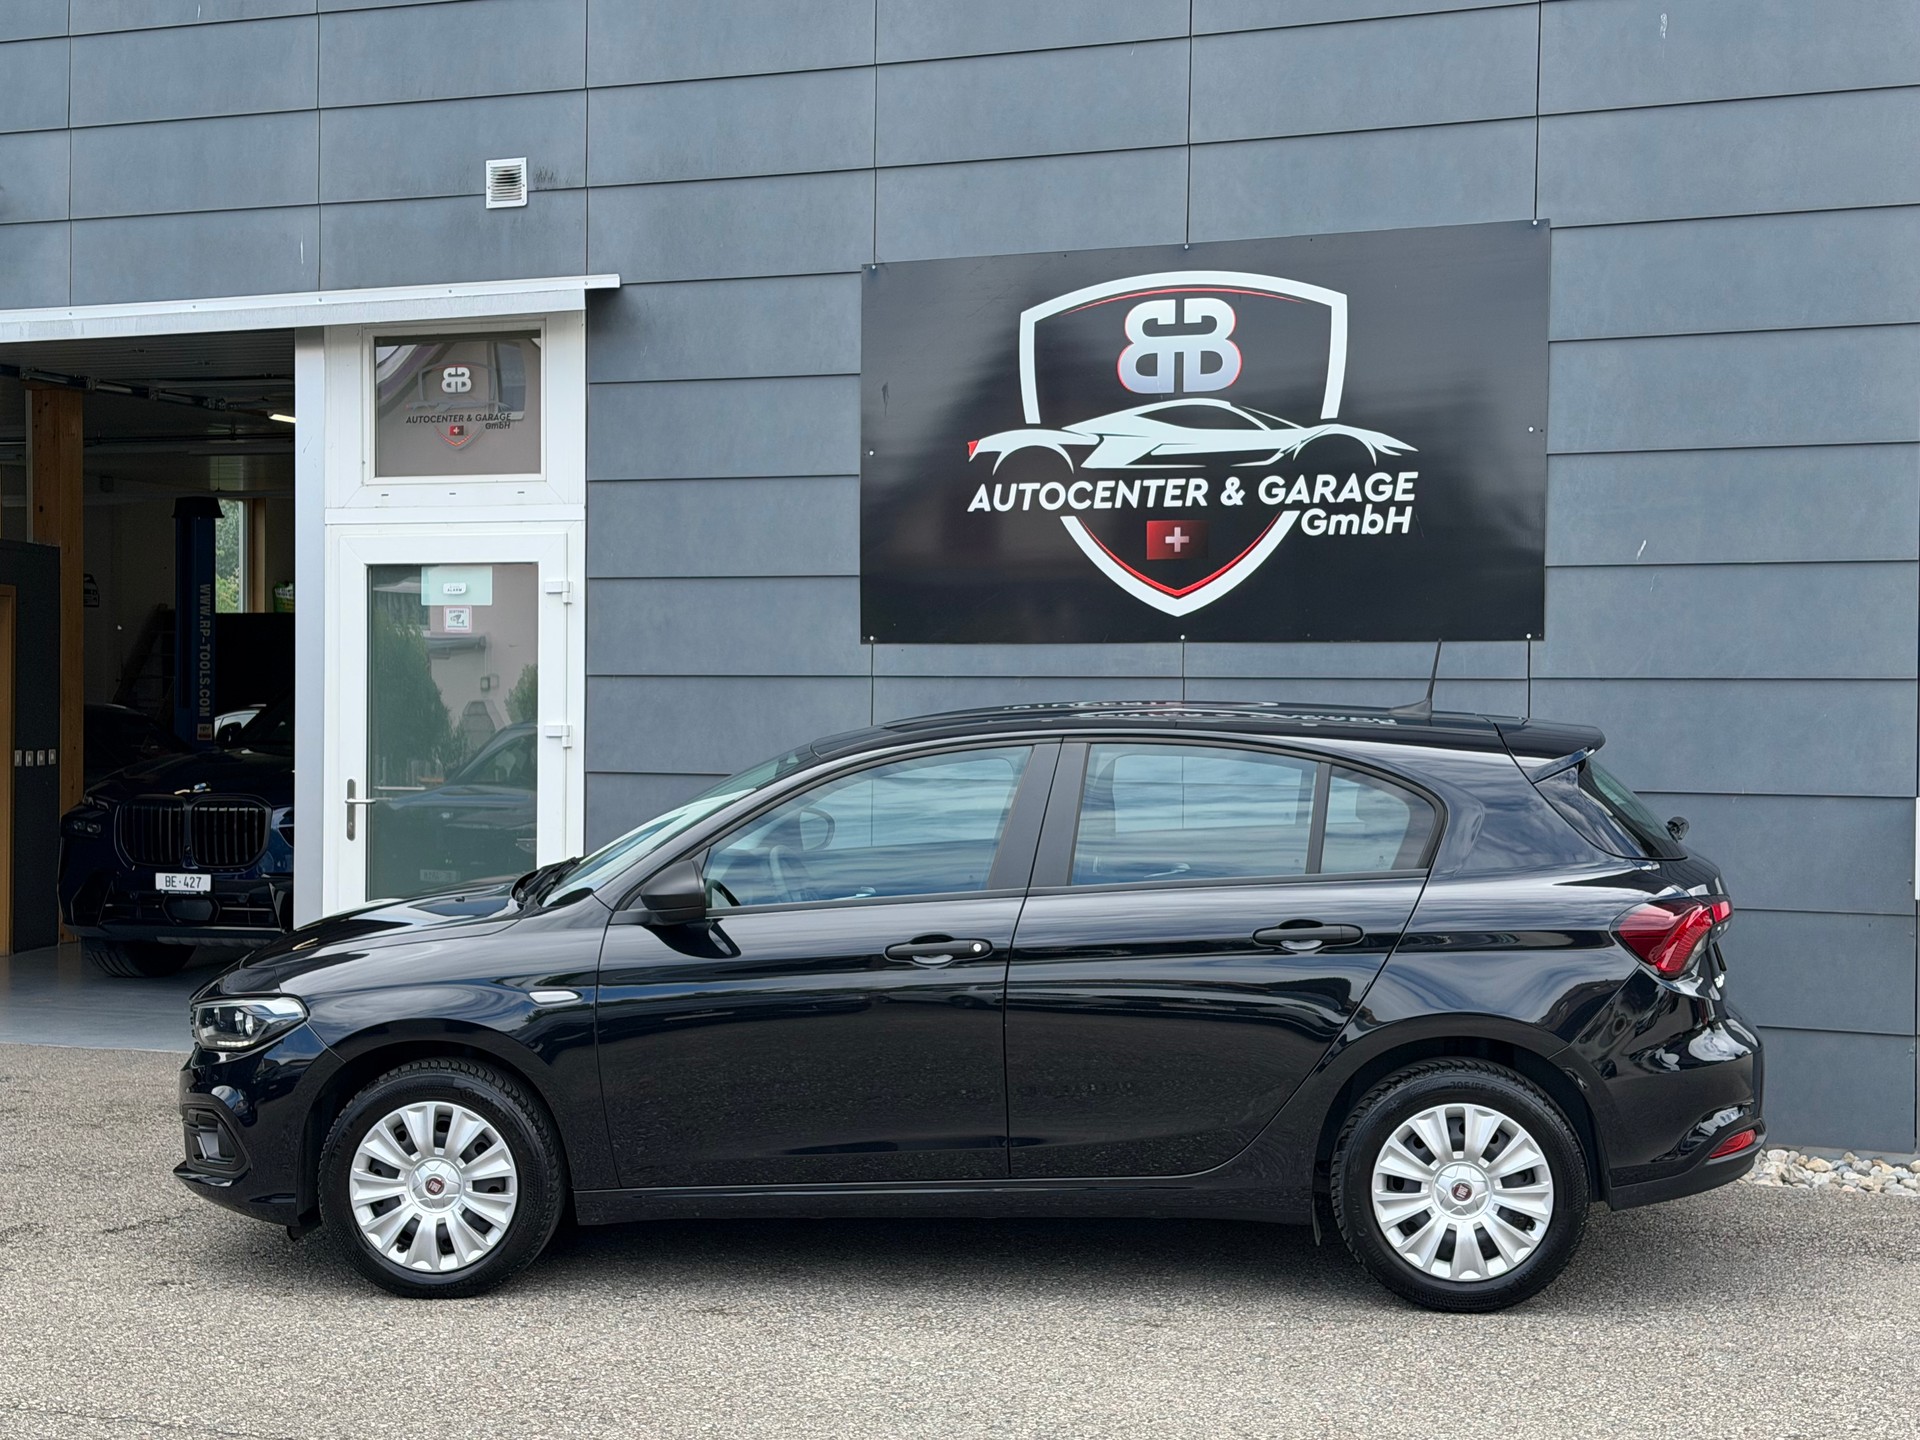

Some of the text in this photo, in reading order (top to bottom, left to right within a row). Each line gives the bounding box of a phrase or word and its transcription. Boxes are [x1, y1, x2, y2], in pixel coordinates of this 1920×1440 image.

[406, 413, 512, 424] AUTOCENTER & GARAGE
[485, 422, 511, 430] GmbH
[967, 472, 1419, 513] AUTOCENTER & GARAGE
[1301, 504, 1413, 536] GmbH
[199, 584, 211, 717] WWW.RP-TOOLS.COM
